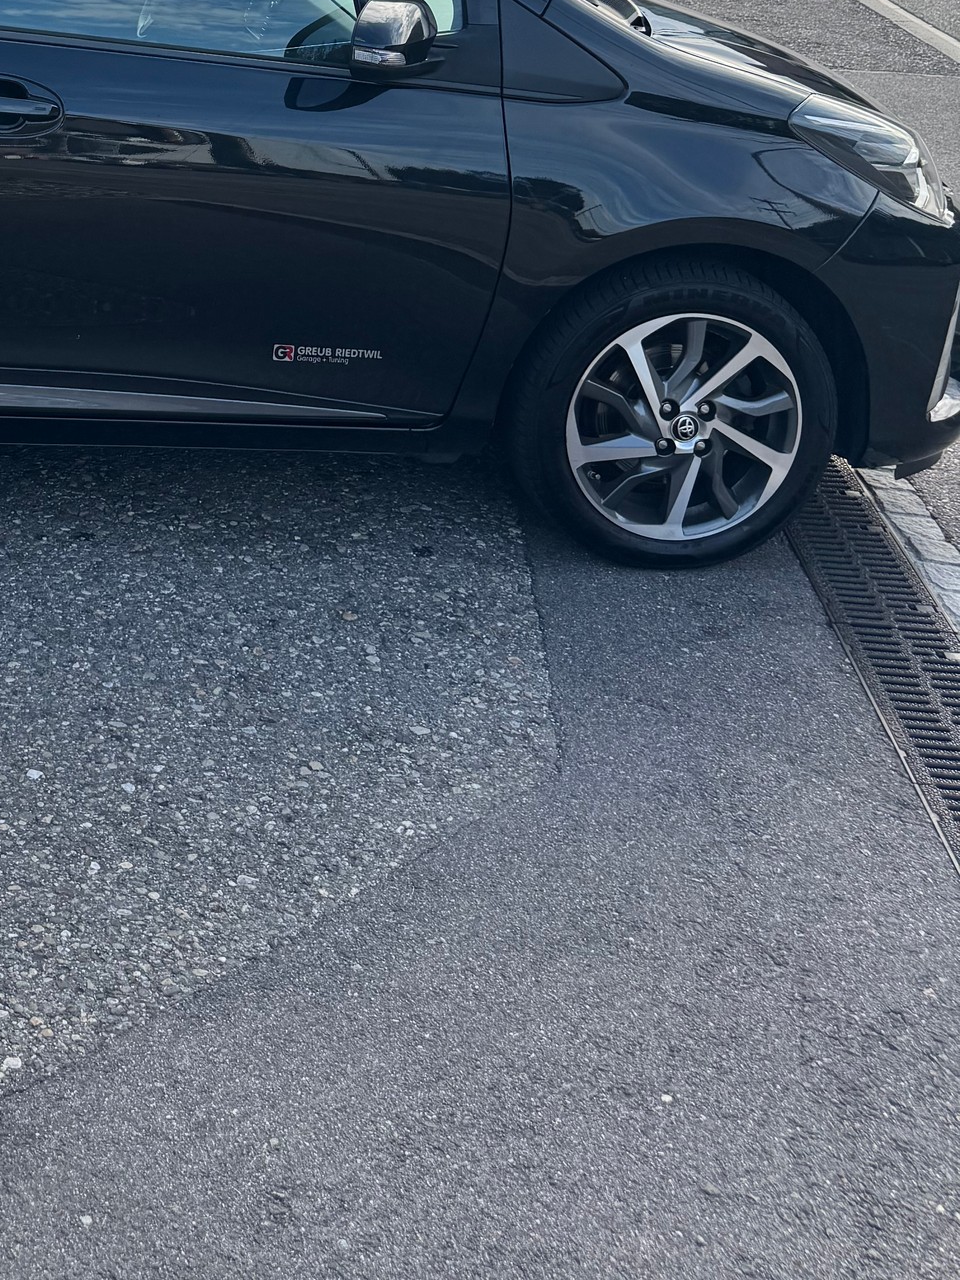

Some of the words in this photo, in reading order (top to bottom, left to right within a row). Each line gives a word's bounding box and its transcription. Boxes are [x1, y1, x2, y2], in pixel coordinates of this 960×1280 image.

[297, 346, 332, 356] GREUB
[335, 348, 383, 359] RIEDTWIL
[296, 355, 321, 363] Garage
[328, 356, 349, 365] Tuning
